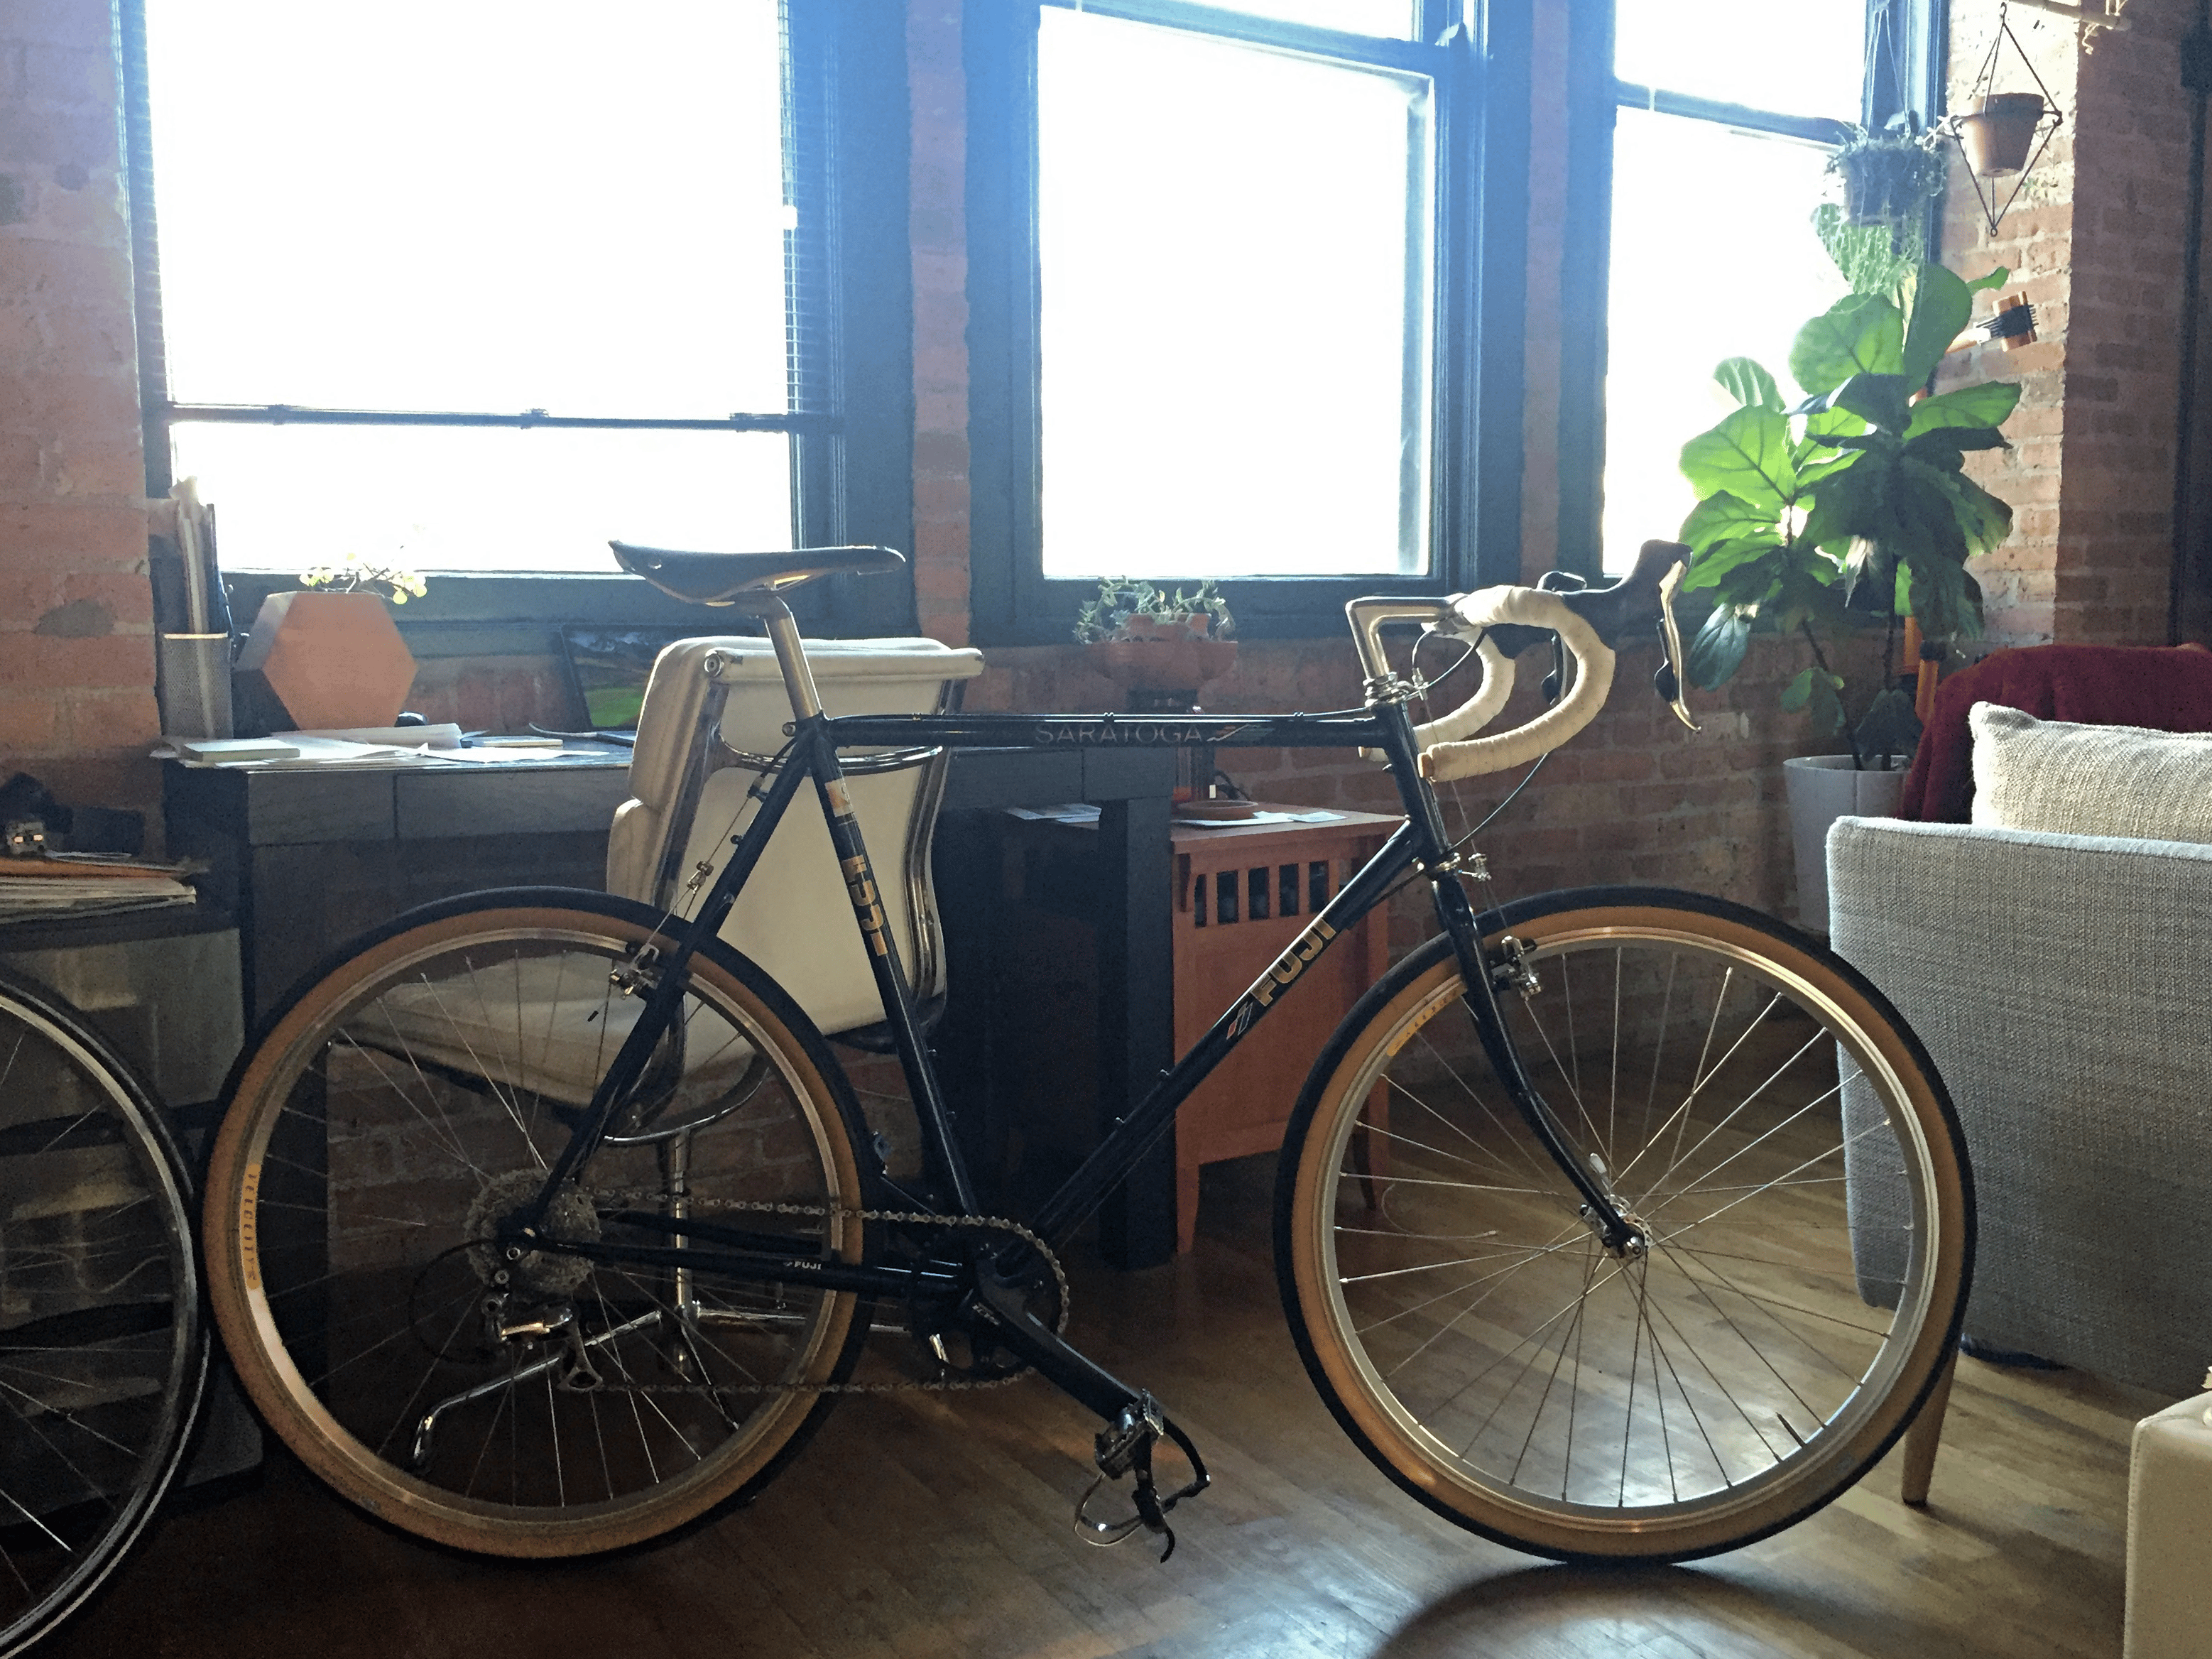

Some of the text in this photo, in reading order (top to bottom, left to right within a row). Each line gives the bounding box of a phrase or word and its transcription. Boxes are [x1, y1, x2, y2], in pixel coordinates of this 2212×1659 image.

[1035, 723, 1202, 743] SARATOGA
[842, 855, 888, 956] FUJI
[1251, 918, 1336, 1006] FUJI
[795, 1261, 822, 1270] FUJI
